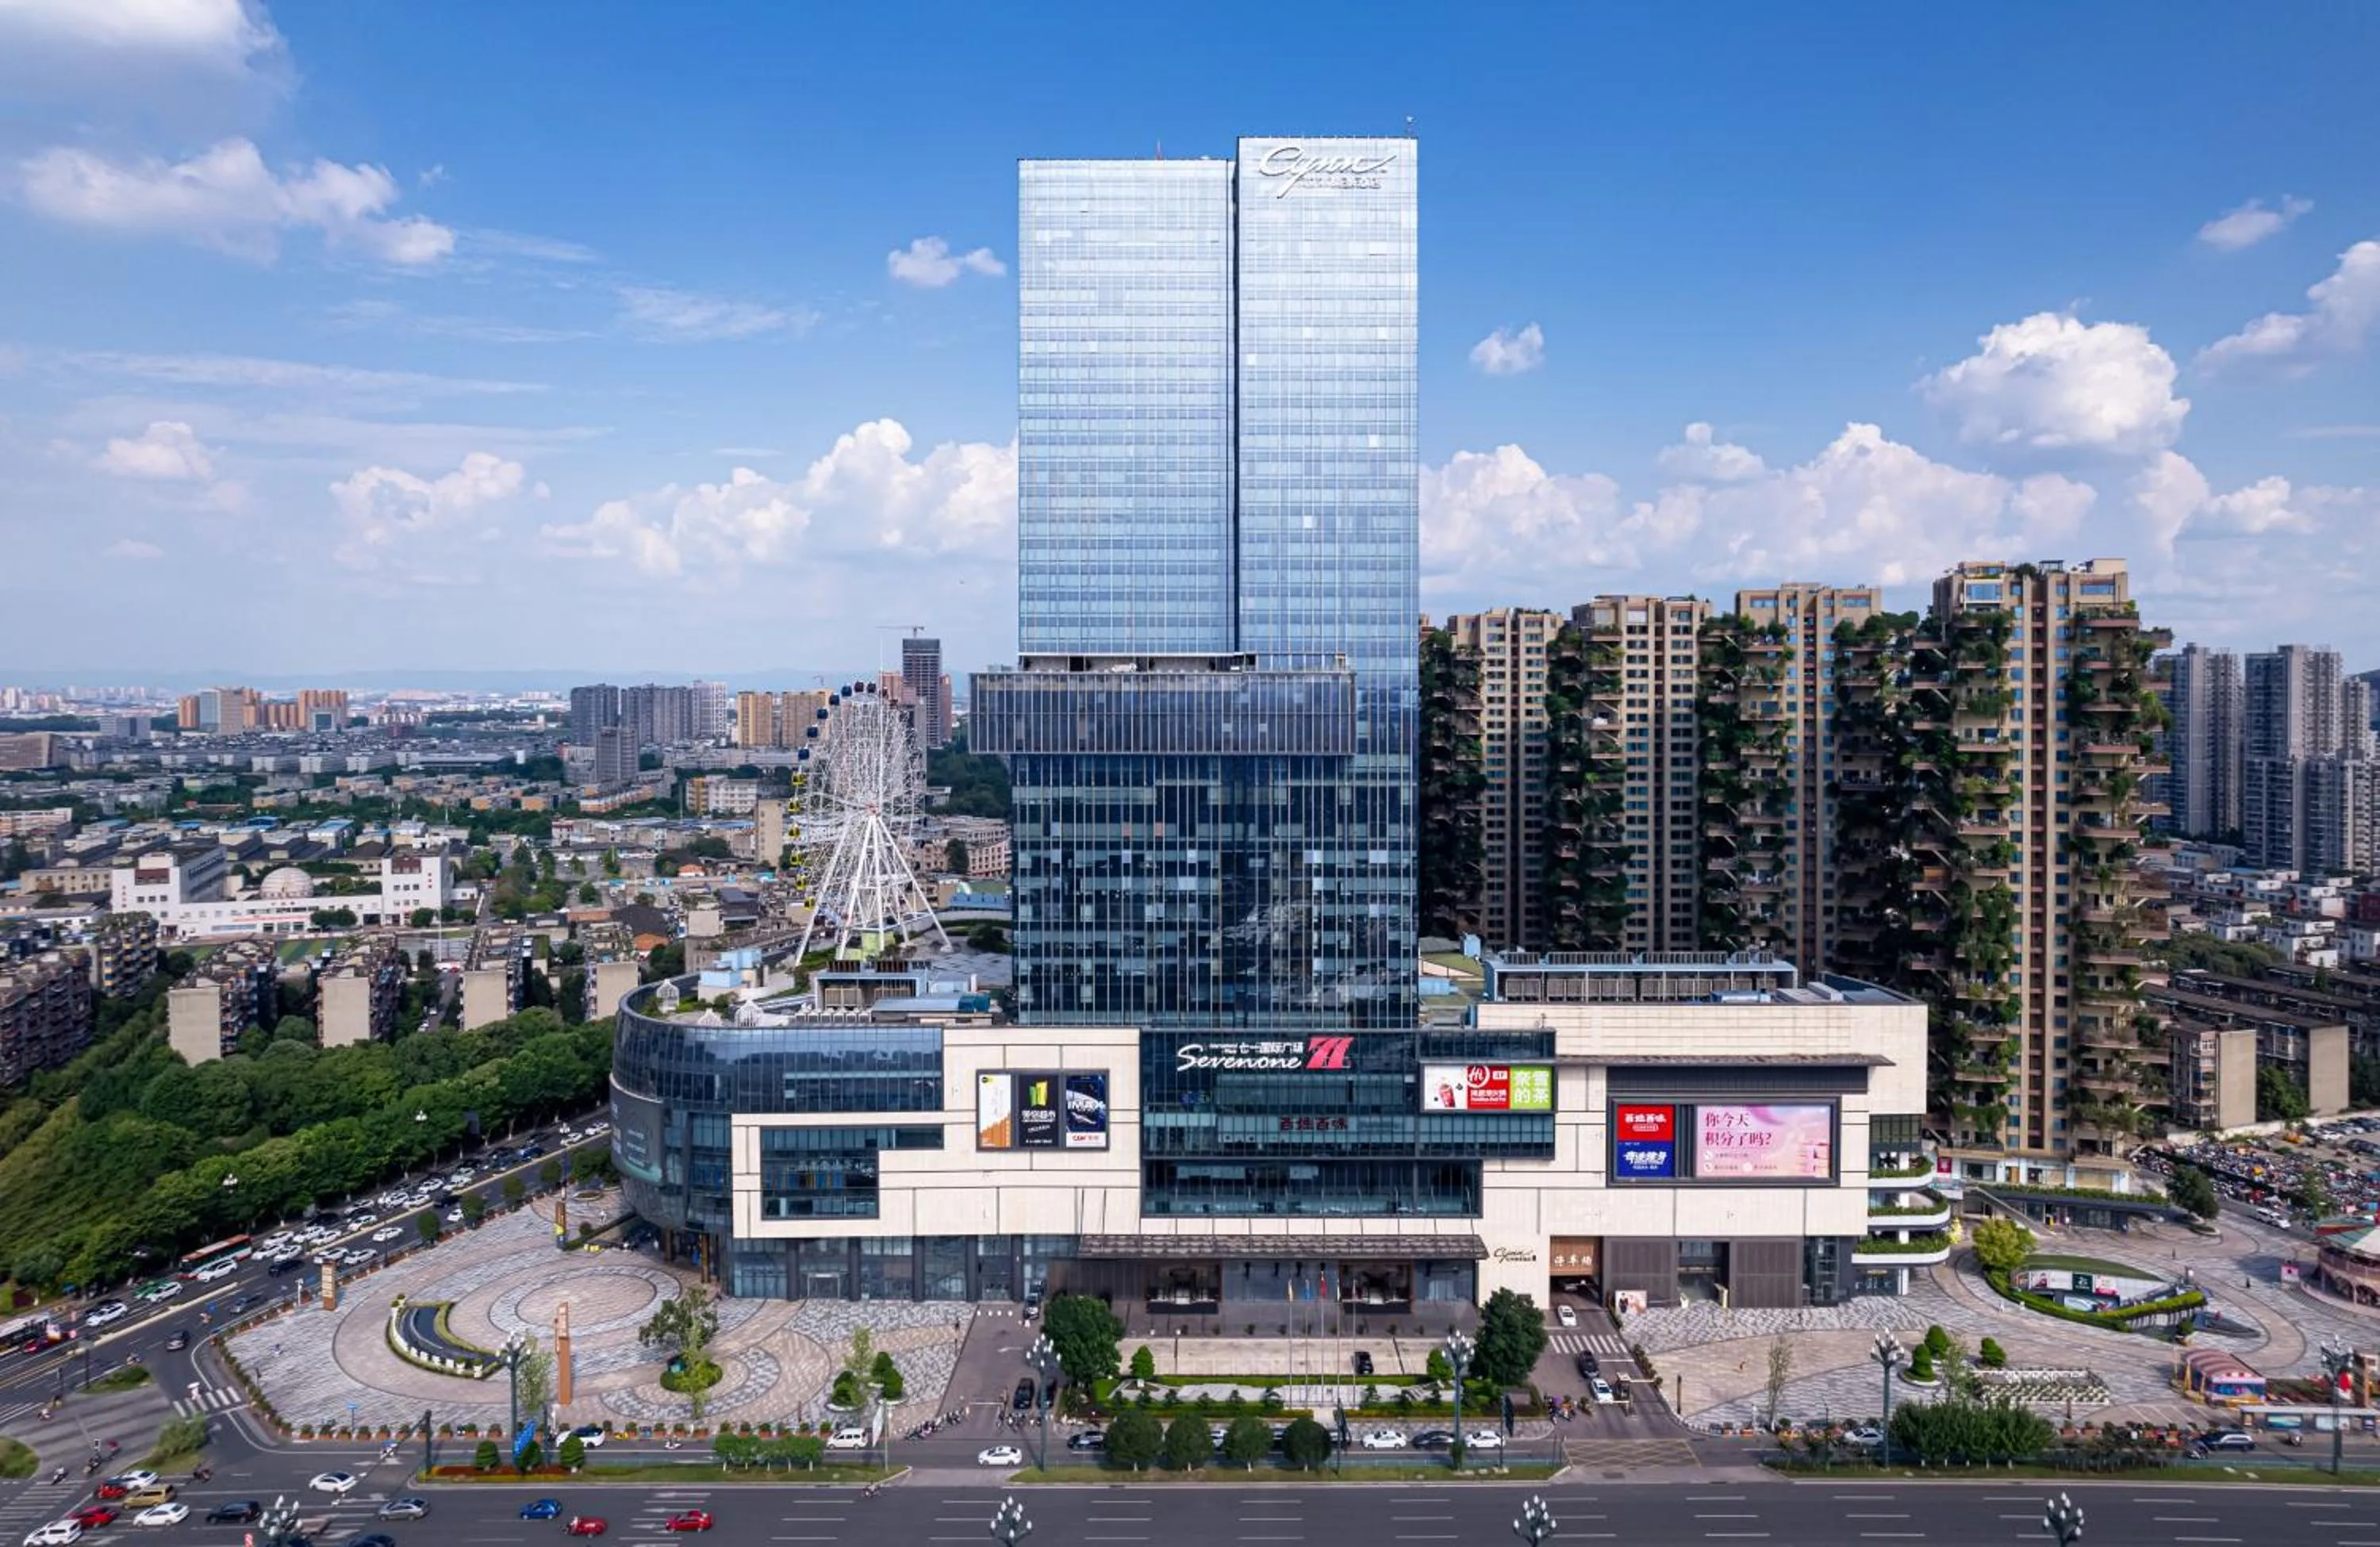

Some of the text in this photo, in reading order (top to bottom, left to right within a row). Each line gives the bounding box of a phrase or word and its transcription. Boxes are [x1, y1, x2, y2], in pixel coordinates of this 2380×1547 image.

[1177, 1043, 1301, 1072] Sevenone
[1706, 1112, 1750, 1127] 你今天
